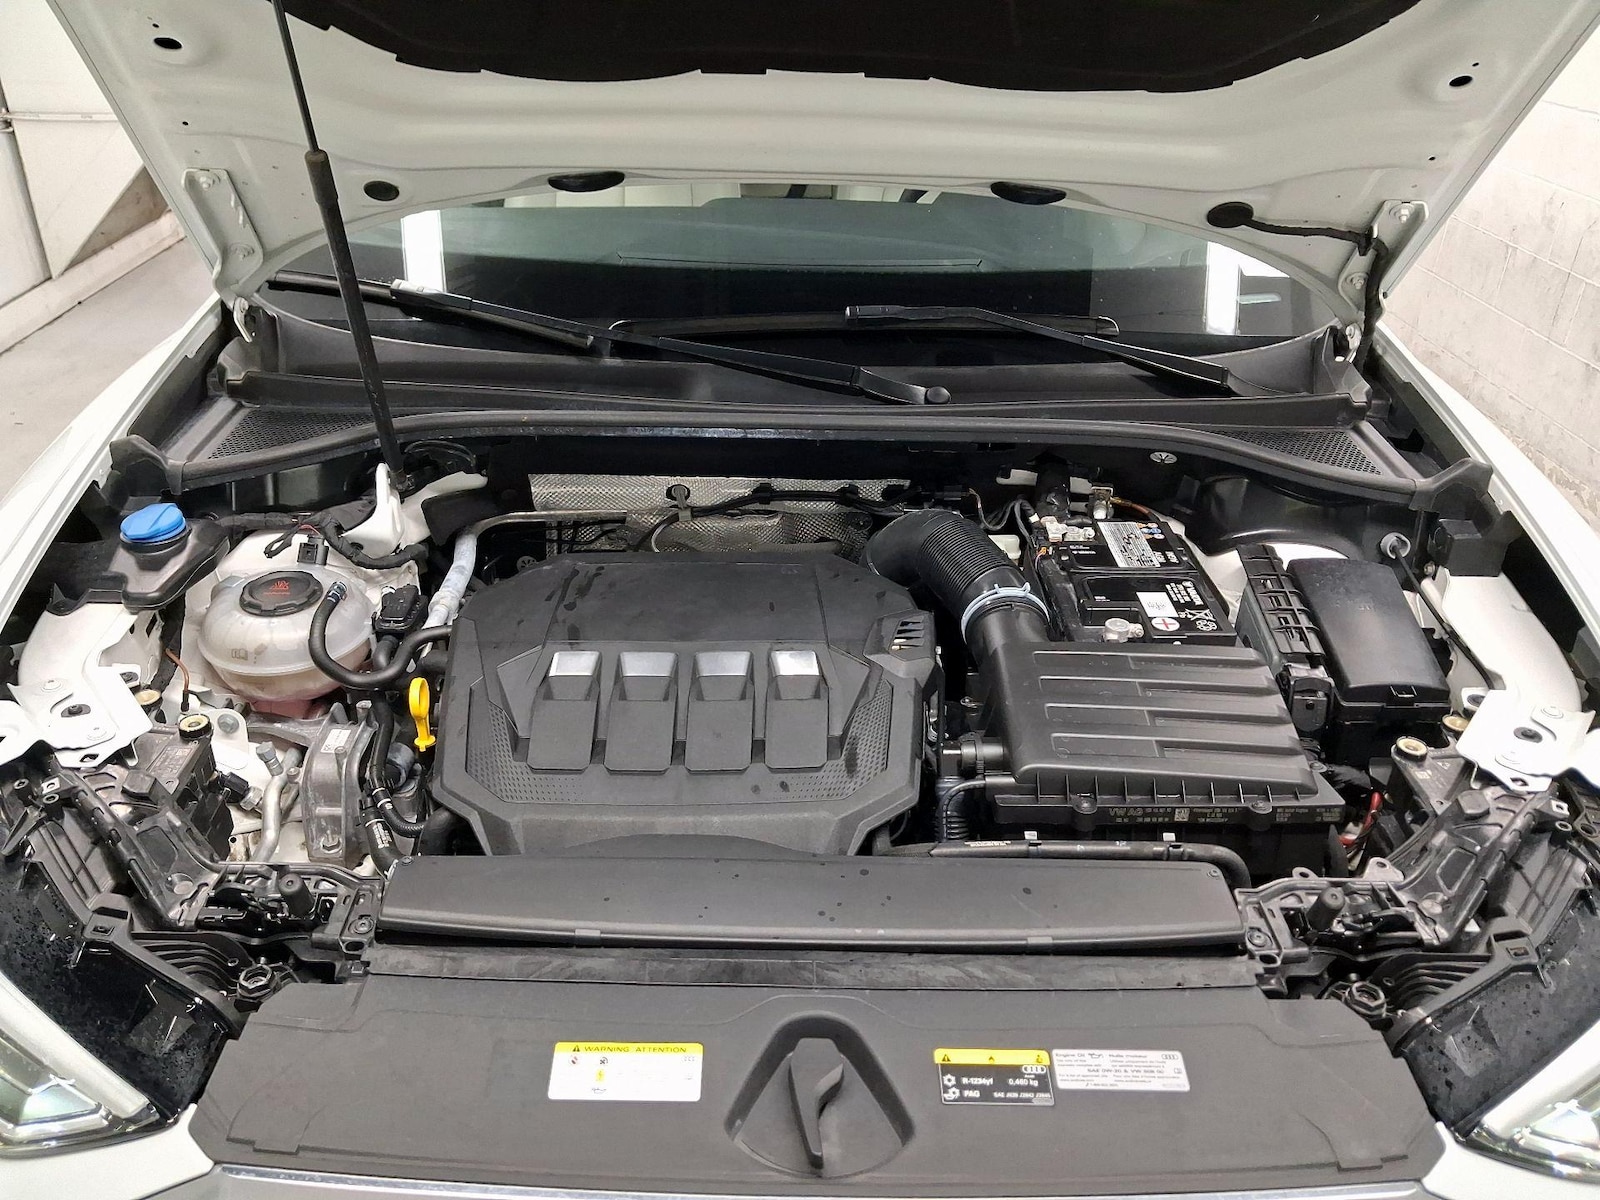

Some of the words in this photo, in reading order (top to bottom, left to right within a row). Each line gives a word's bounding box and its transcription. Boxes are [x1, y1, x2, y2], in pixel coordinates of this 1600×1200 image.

[1108, 807, 1127, 817] VW
[1127, 807, 1144, 817] AG
[1055, 1052, 1075, 1060] Engine
[961, 1077, 994, 1087] R-1234yf
[1029, 1078, 1039, 1087] kg
[962, 1089, 981, 1099] PAG
